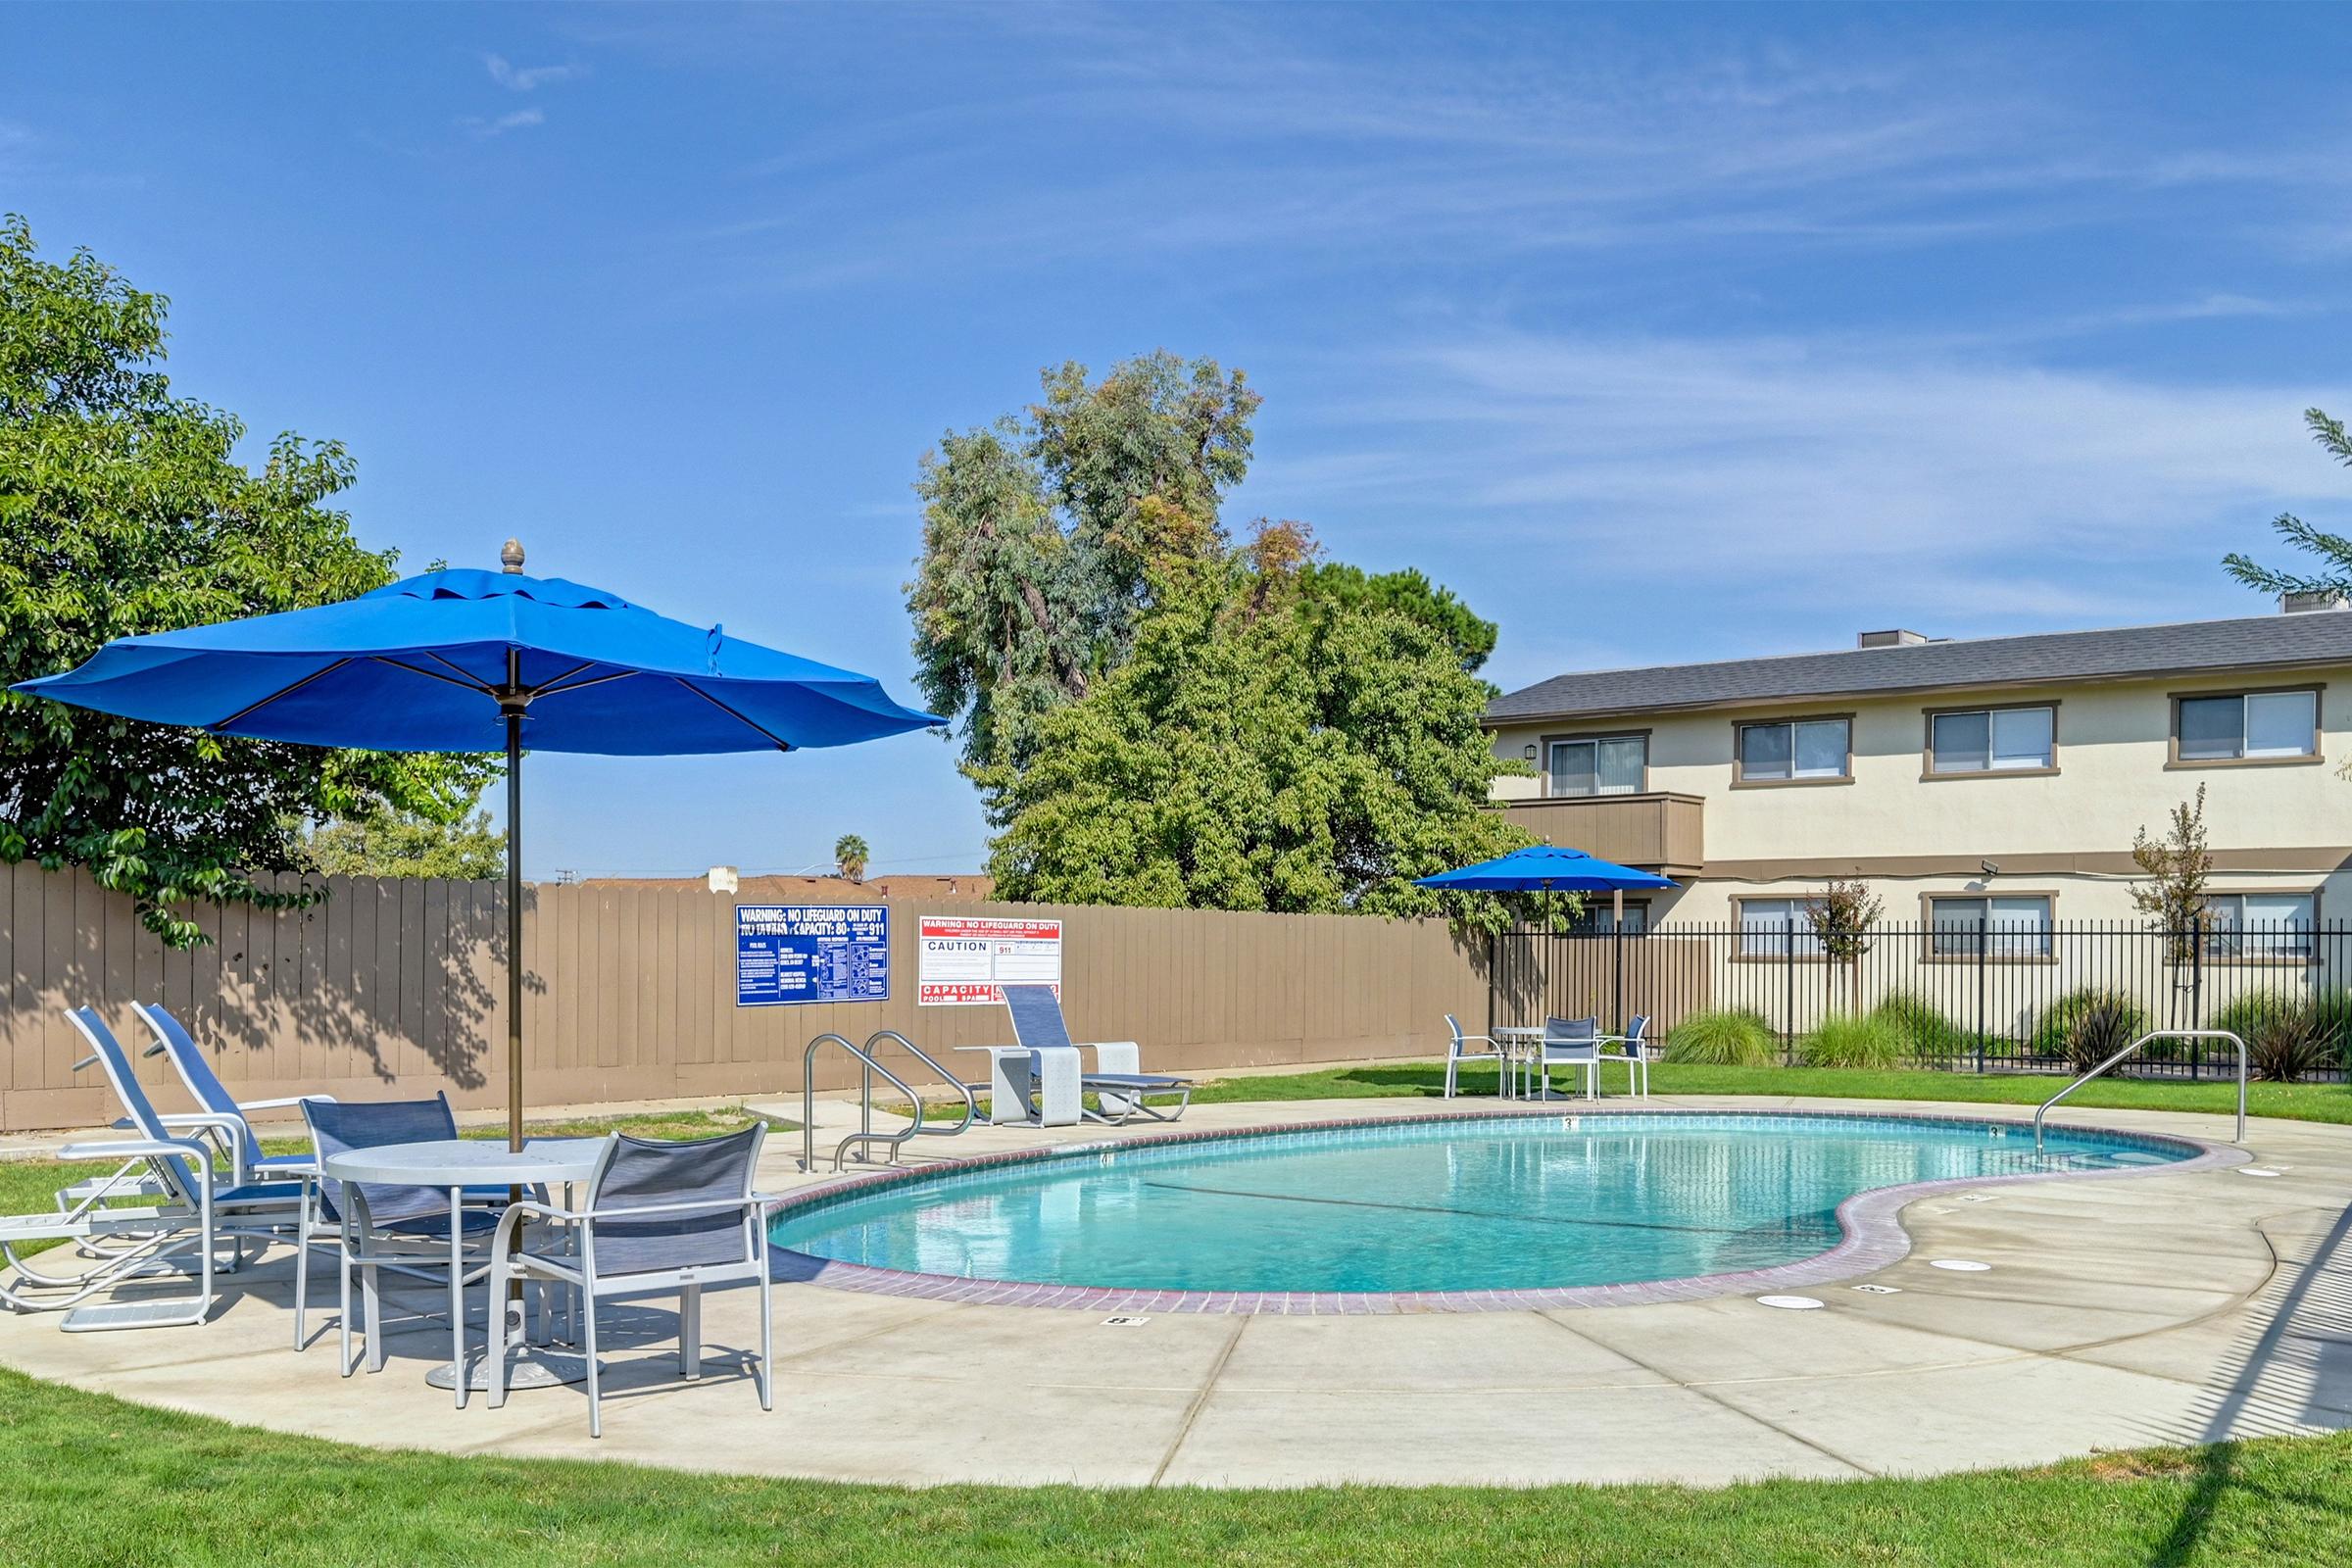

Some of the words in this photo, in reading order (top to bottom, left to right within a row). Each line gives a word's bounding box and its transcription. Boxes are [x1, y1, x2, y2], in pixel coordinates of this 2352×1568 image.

[740, 908, 787, 922] WARNING:
[788, 908, 802, 922] NO
[803, 908, 846, 922] LIFEGUARD
[847, 908, 860, 922] ON
[861, 908, 882, 922] DUTY
[868, 922, 885, 936] 911
[980, 921, 1024, 930] LIFEGUARD
[928, 941, 987, 951] CAUTION
[923, 986, 990, 995] CAPACITY
